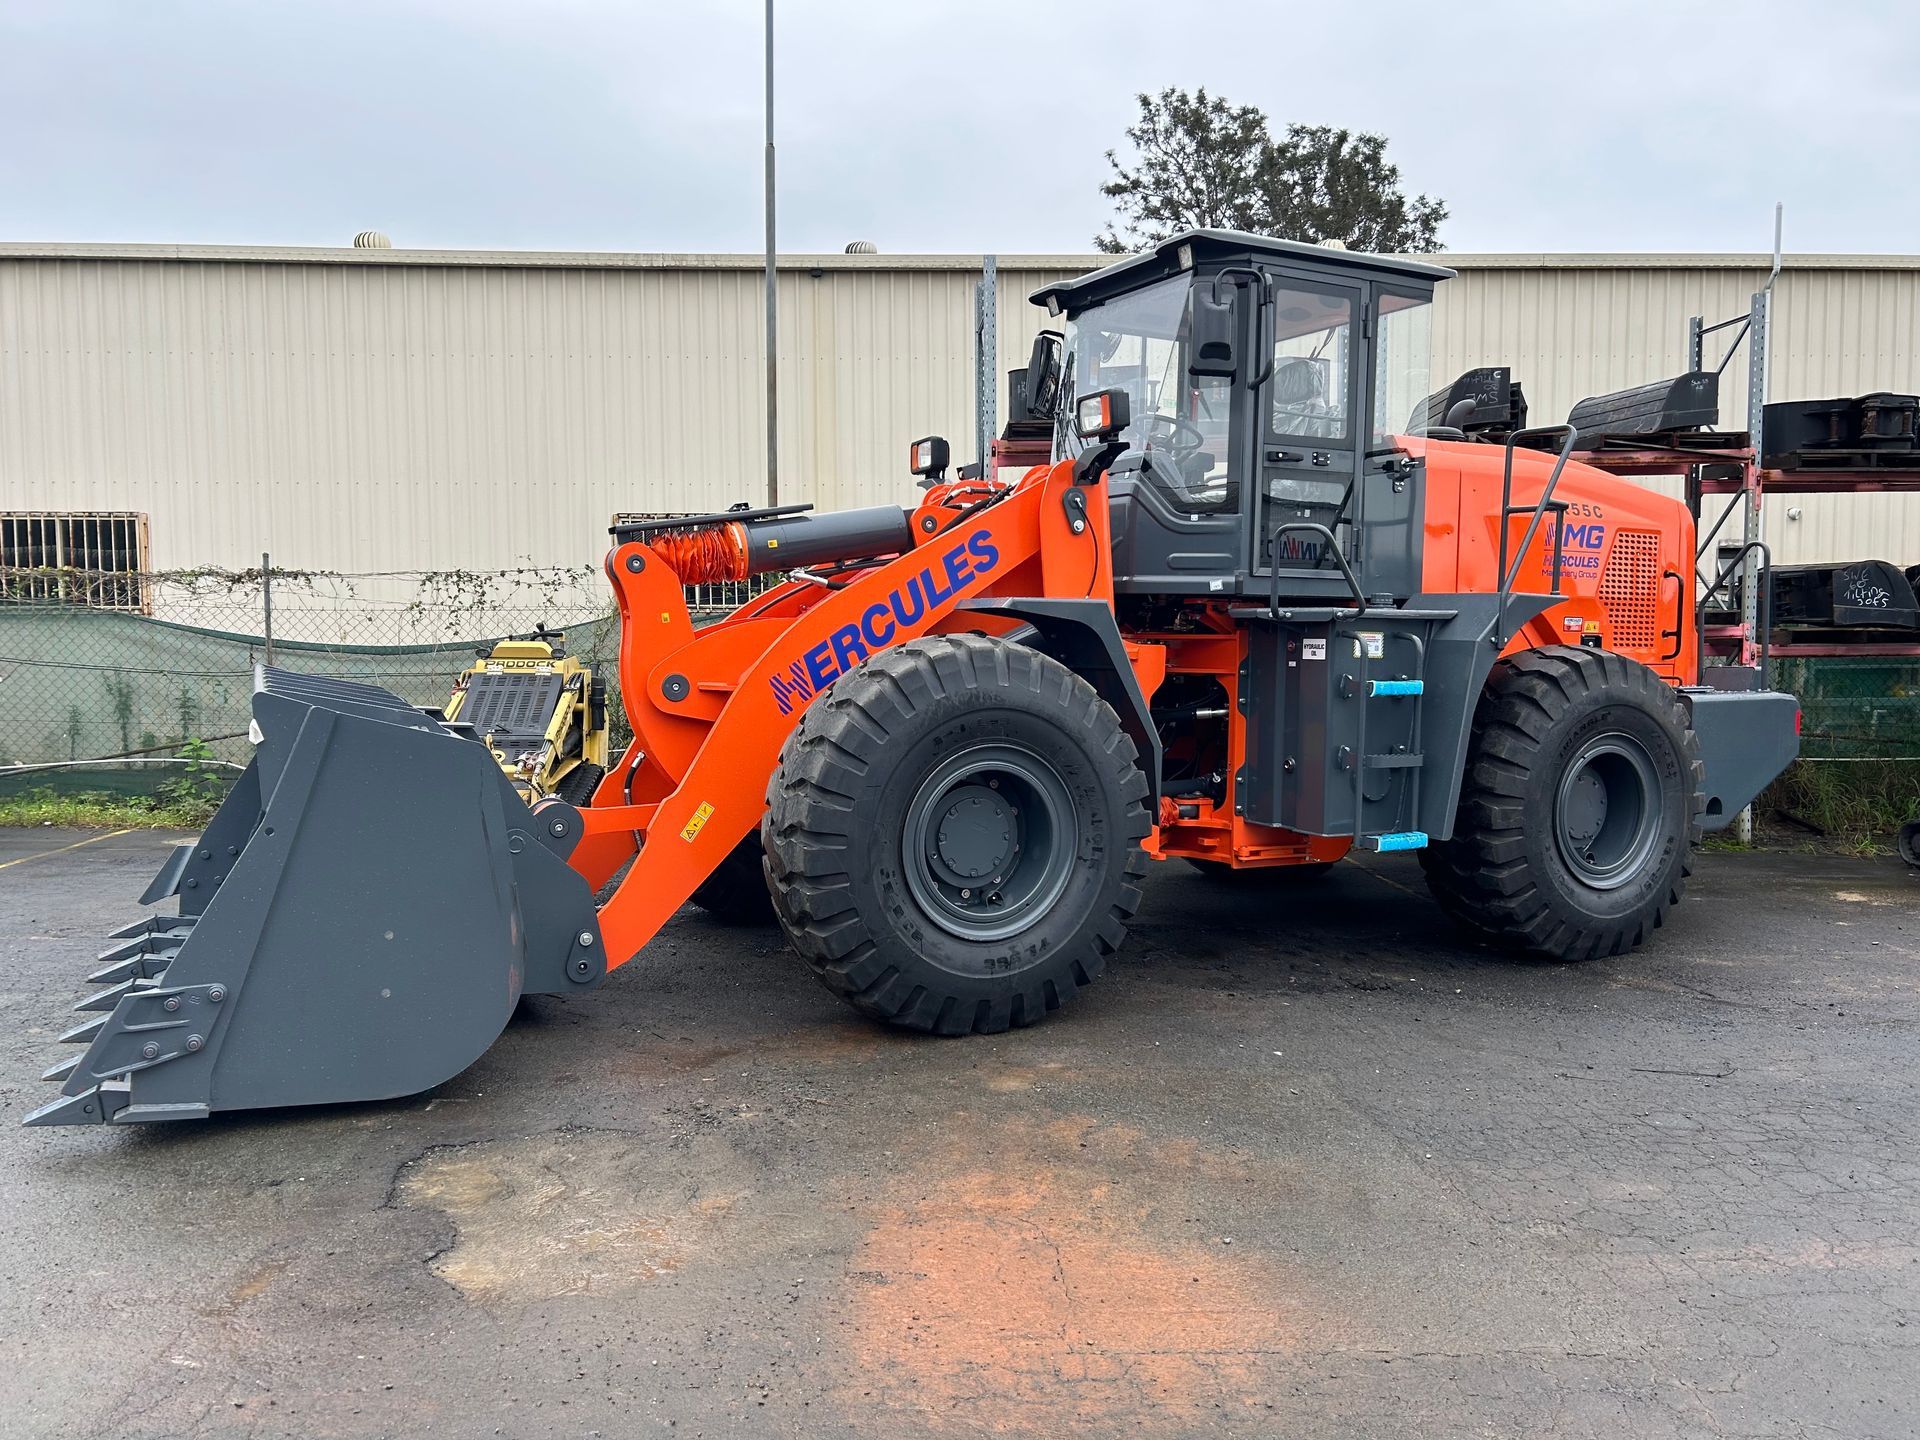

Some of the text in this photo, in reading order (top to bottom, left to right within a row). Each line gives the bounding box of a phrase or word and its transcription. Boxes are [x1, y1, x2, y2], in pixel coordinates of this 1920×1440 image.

[1542, 555, 1600, 568] HRCULES
[768, 529, 999, 716] HERCULES
[485, 660, 556, 669] PADDOCK
